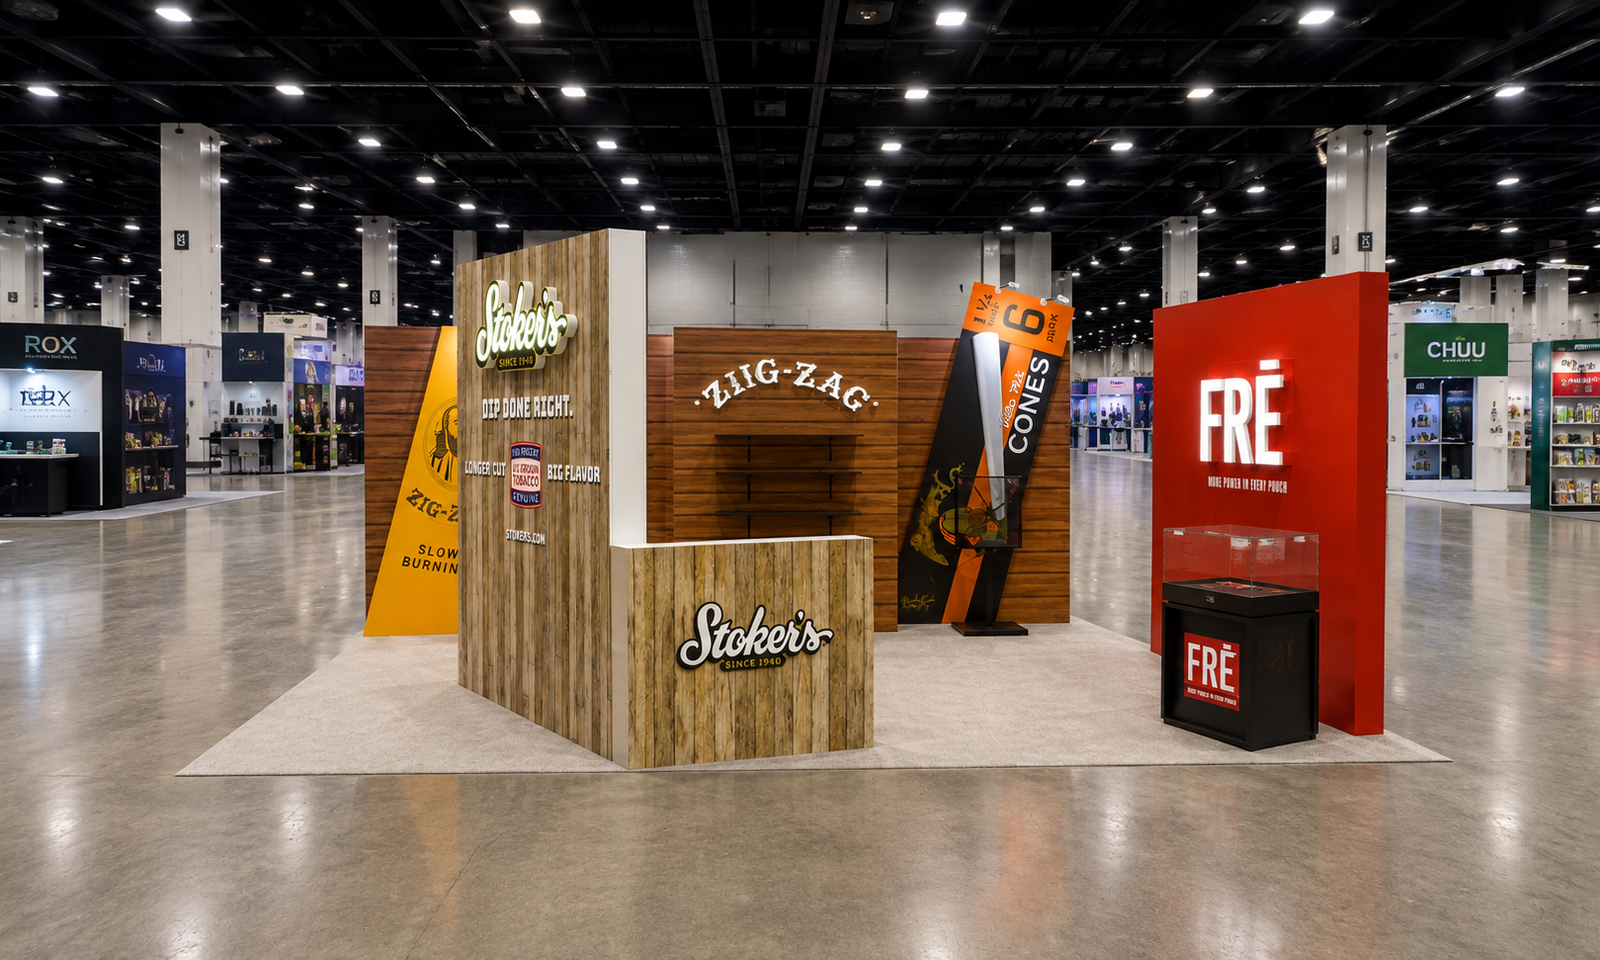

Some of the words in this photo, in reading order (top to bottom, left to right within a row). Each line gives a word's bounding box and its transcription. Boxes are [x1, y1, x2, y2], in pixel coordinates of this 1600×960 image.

[476, 283, 568, 363] Stoker's
[1003, 304, 1045, 335] 6
[25, 335, 77, 354] ROX
[1427, 341, 1486, 358] CHUU
[482, 399, 500, 419] DIP
[502, 397, 531, 419] DONE
[533, 395, 574, 418] RIGHT.
[1008, 357, 1049, 454] CONES
[493, 462, 506, 477] CUT
[547, 464, 564, 481] BIG
[565, 465, 601, 483] FLAVOR
[418, 544, 458, 560] SLOW
[679, 602, 834, 666] Stoker's
[725, 660, 755, 669] SINCE
[758, 657, 782, 666] 1940
